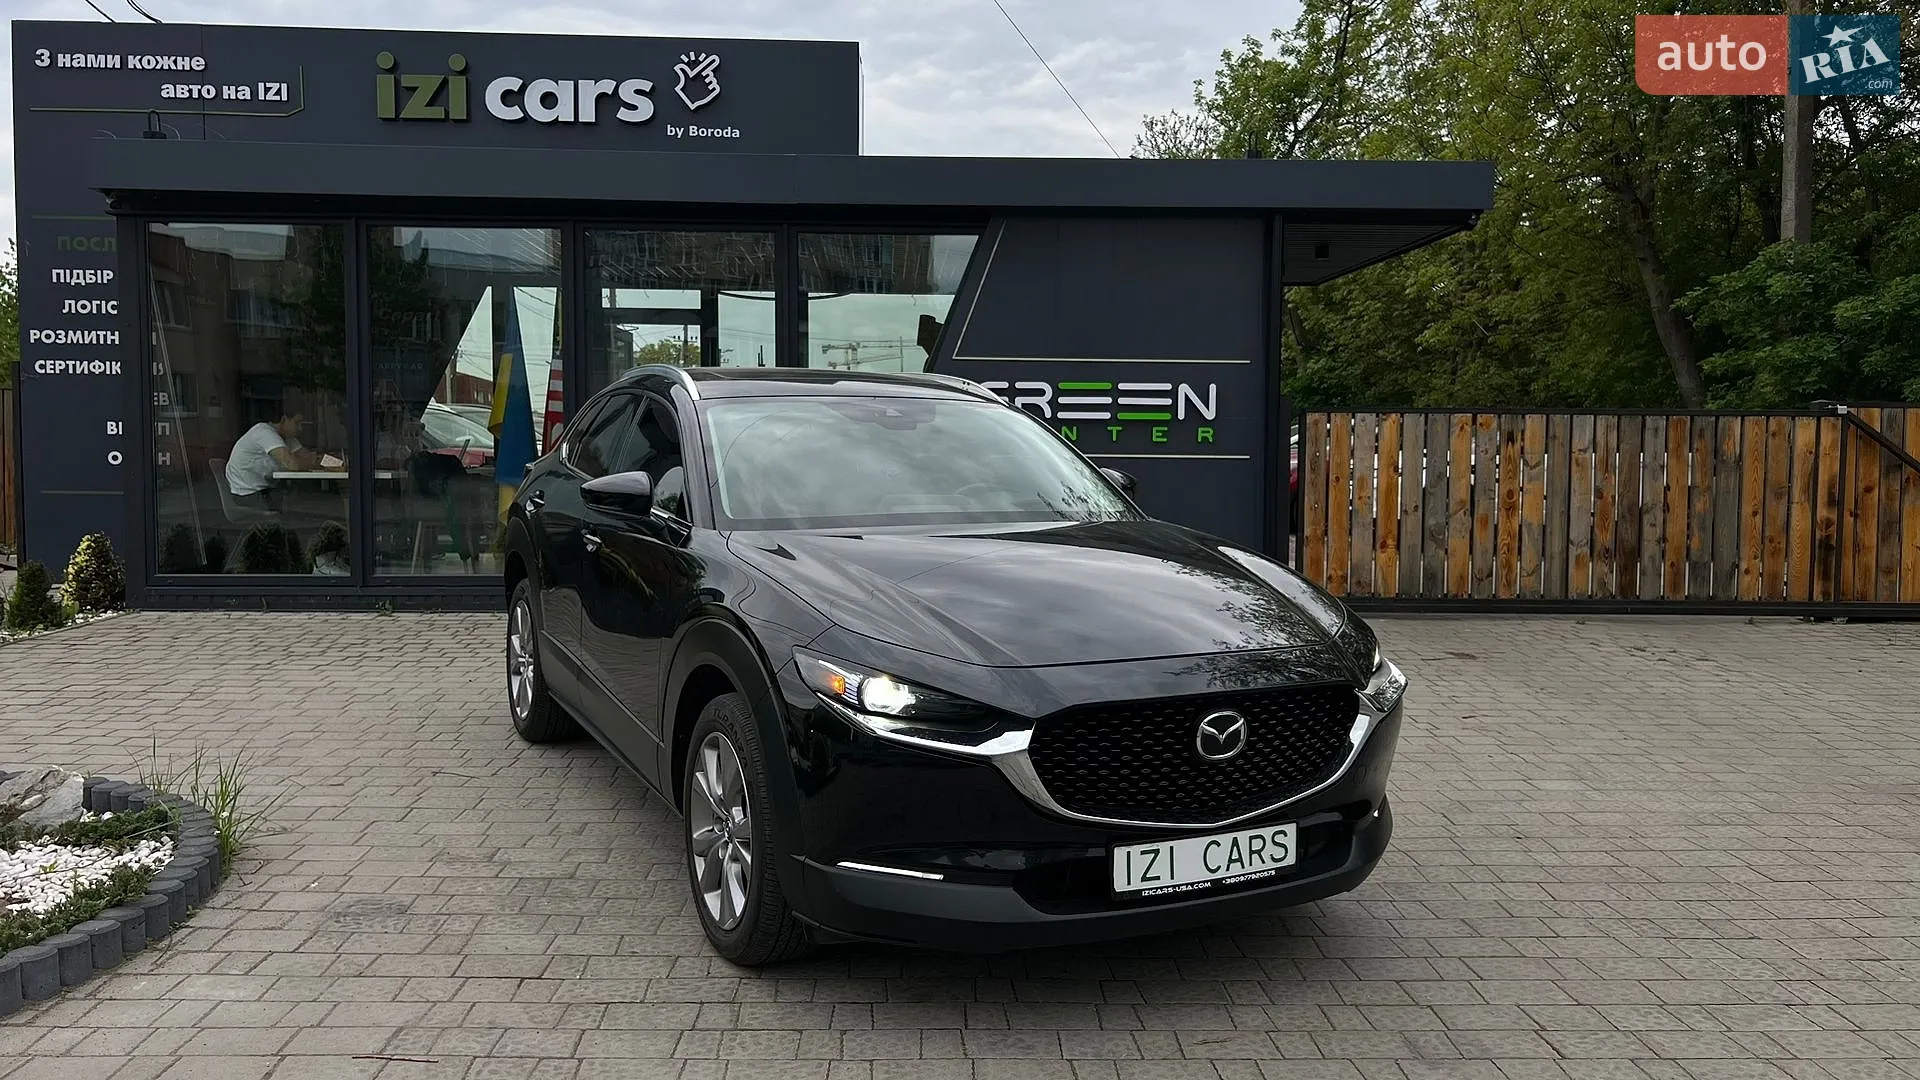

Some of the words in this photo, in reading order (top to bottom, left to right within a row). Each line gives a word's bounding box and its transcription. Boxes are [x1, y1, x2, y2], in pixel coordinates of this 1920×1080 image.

[57, 52, 121, 70] нами
[127, 53, 206, 71] кожне
[160, 83, 216, 100] авто
[222, 84, 251, 101] на
[258, 82, 288, 101] IZI
[376, 51, 467, 120] izi
[485, 76, 654, 123] cars
[667, 124, 684, 138] by
[688, 124, 740, 139] Boroda
[51, 268, 114, 286] ПІДБІР
[29, 329, 120, 345] РОЗМИТН
[34, 359, 121, 375] СЕРТИФІК
[1125, 845, 1175, 886] IZI
[1202, 829, 1289, 874] CARS
